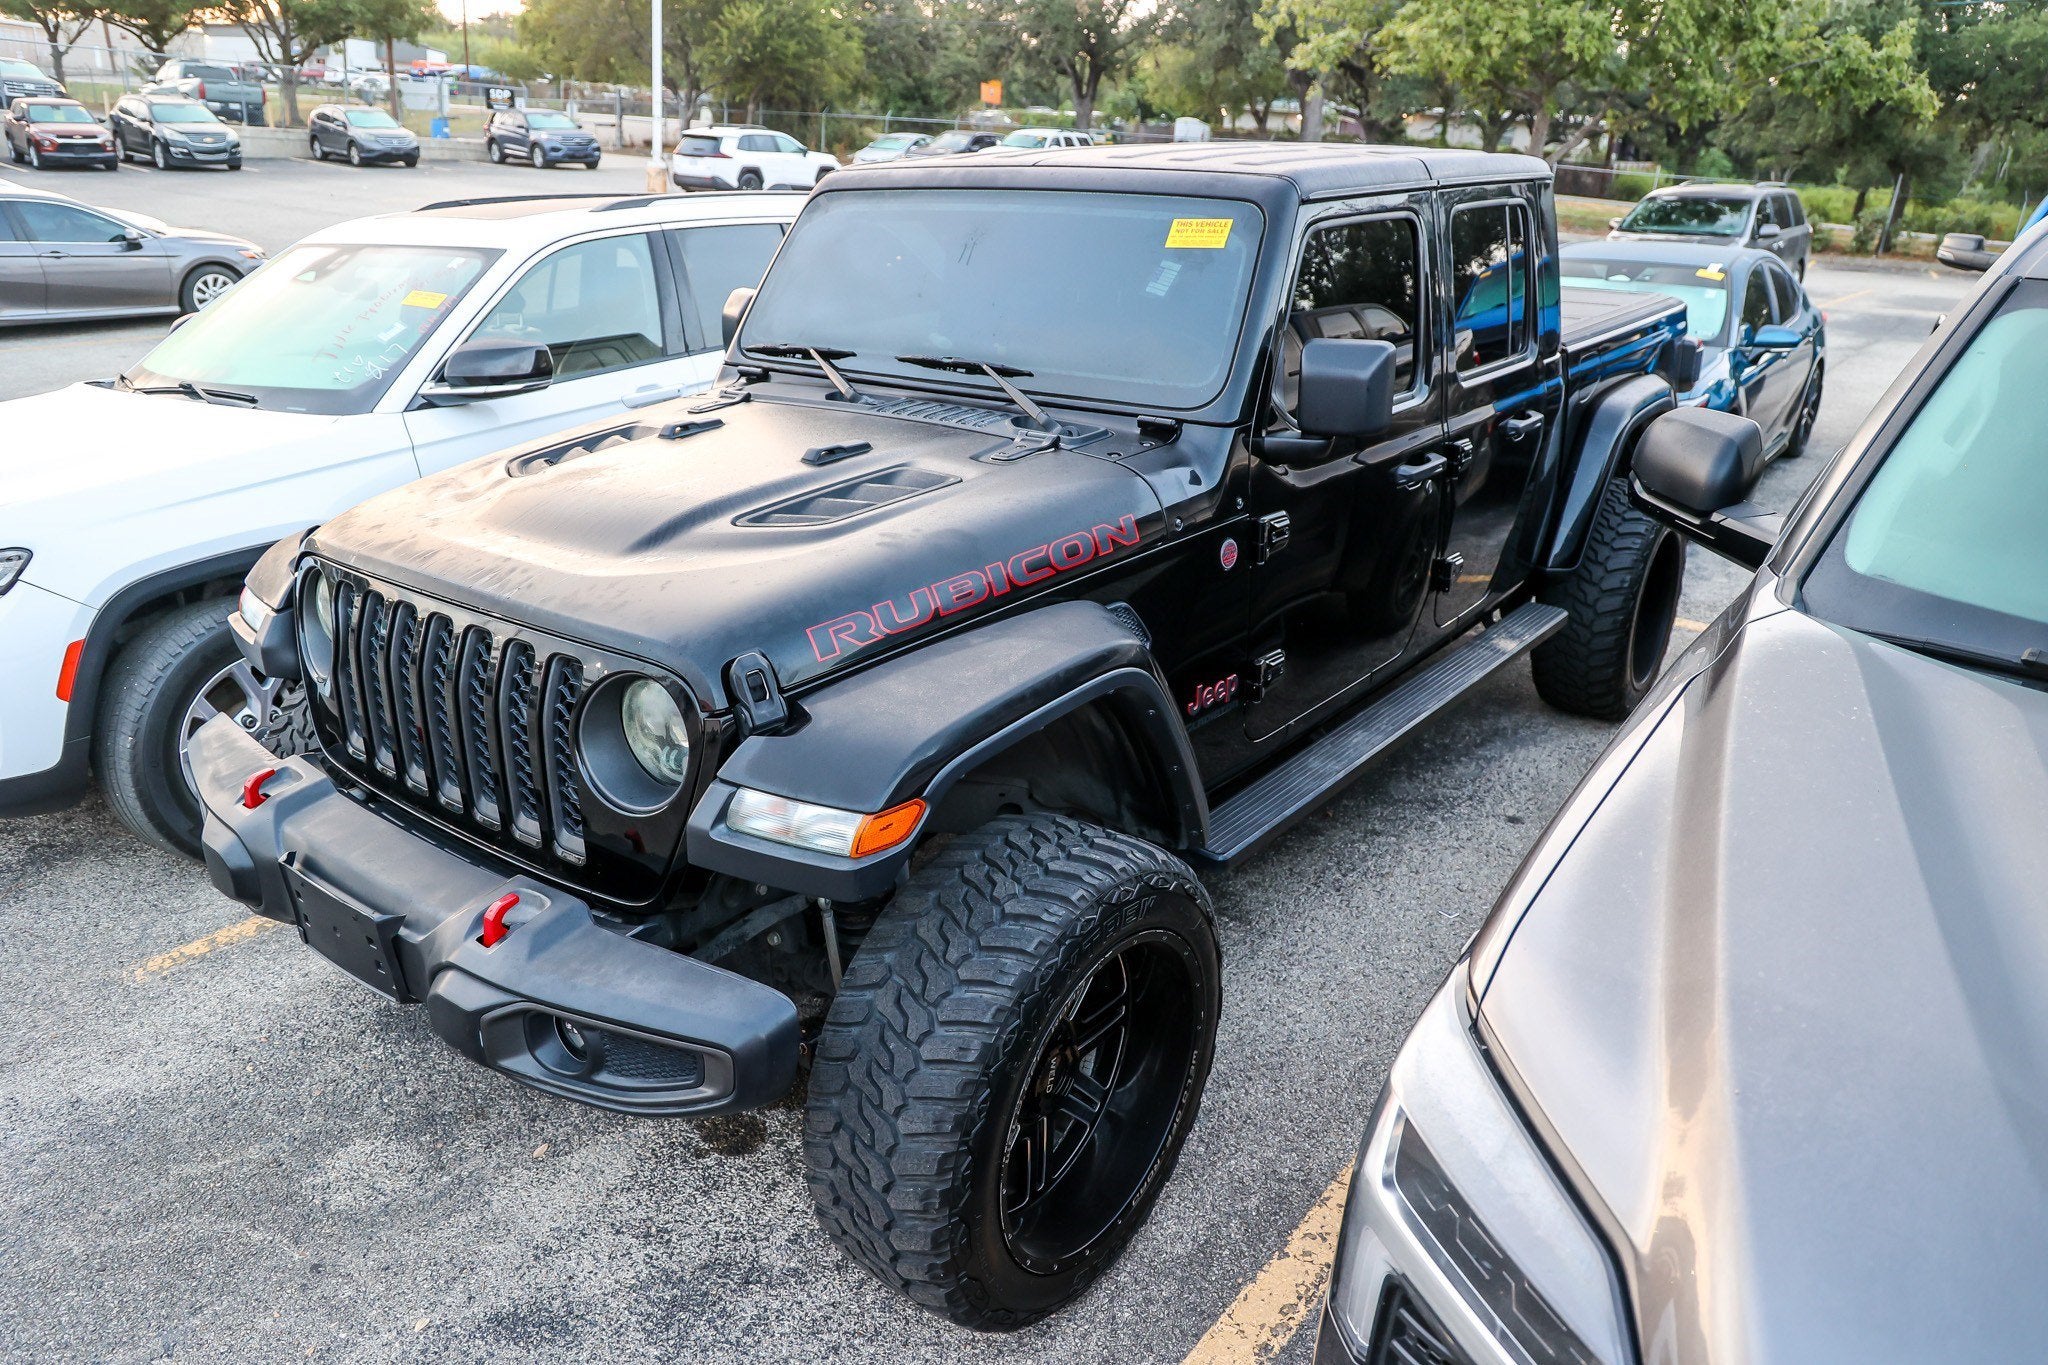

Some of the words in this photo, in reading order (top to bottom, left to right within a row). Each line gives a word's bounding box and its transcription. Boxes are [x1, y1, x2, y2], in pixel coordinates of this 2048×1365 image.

[805, 513, 1142, 663] RUBICON
[1187, 673, 1238, 716] Jeep
[1046, 1056, 1060, 1094] WELD
